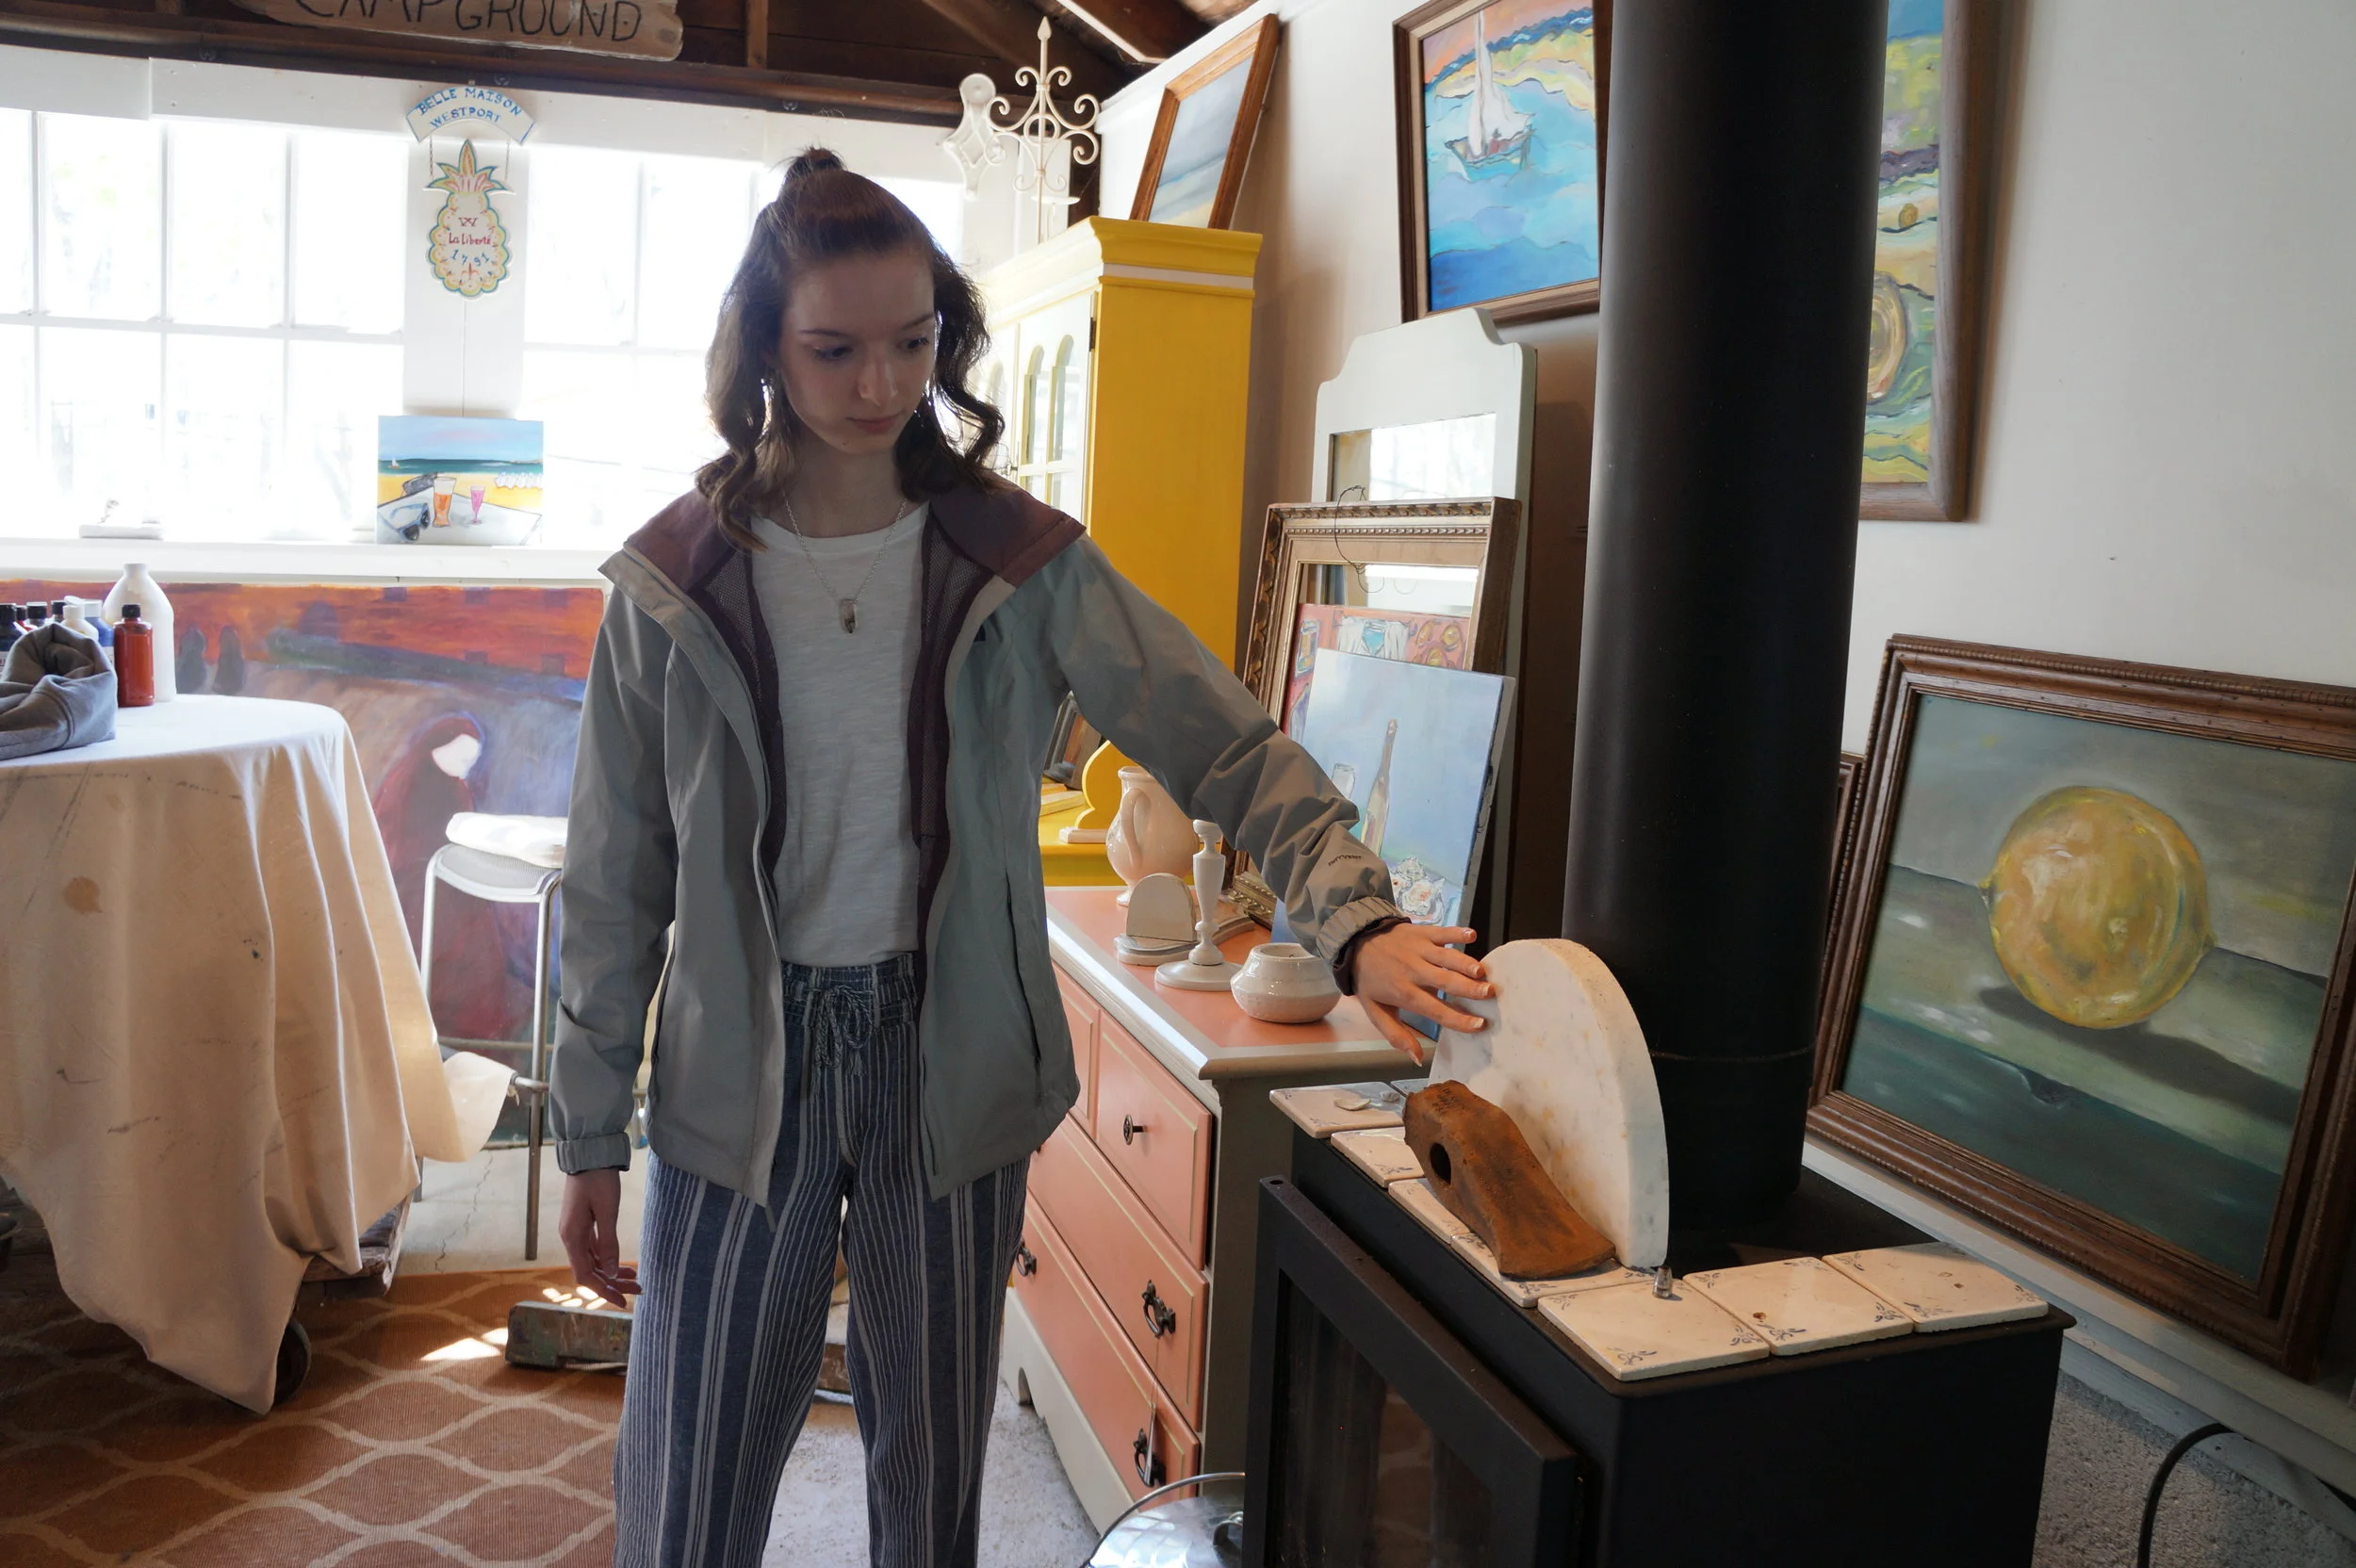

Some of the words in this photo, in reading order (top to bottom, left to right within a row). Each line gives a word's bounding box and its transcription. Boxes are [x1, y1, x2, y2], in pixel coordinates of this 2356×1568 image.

[415, 88, 458, 116] BELLE
[464, 87, 522, 116] MAISON
[429, 106, 501, 128] WESTPORT
